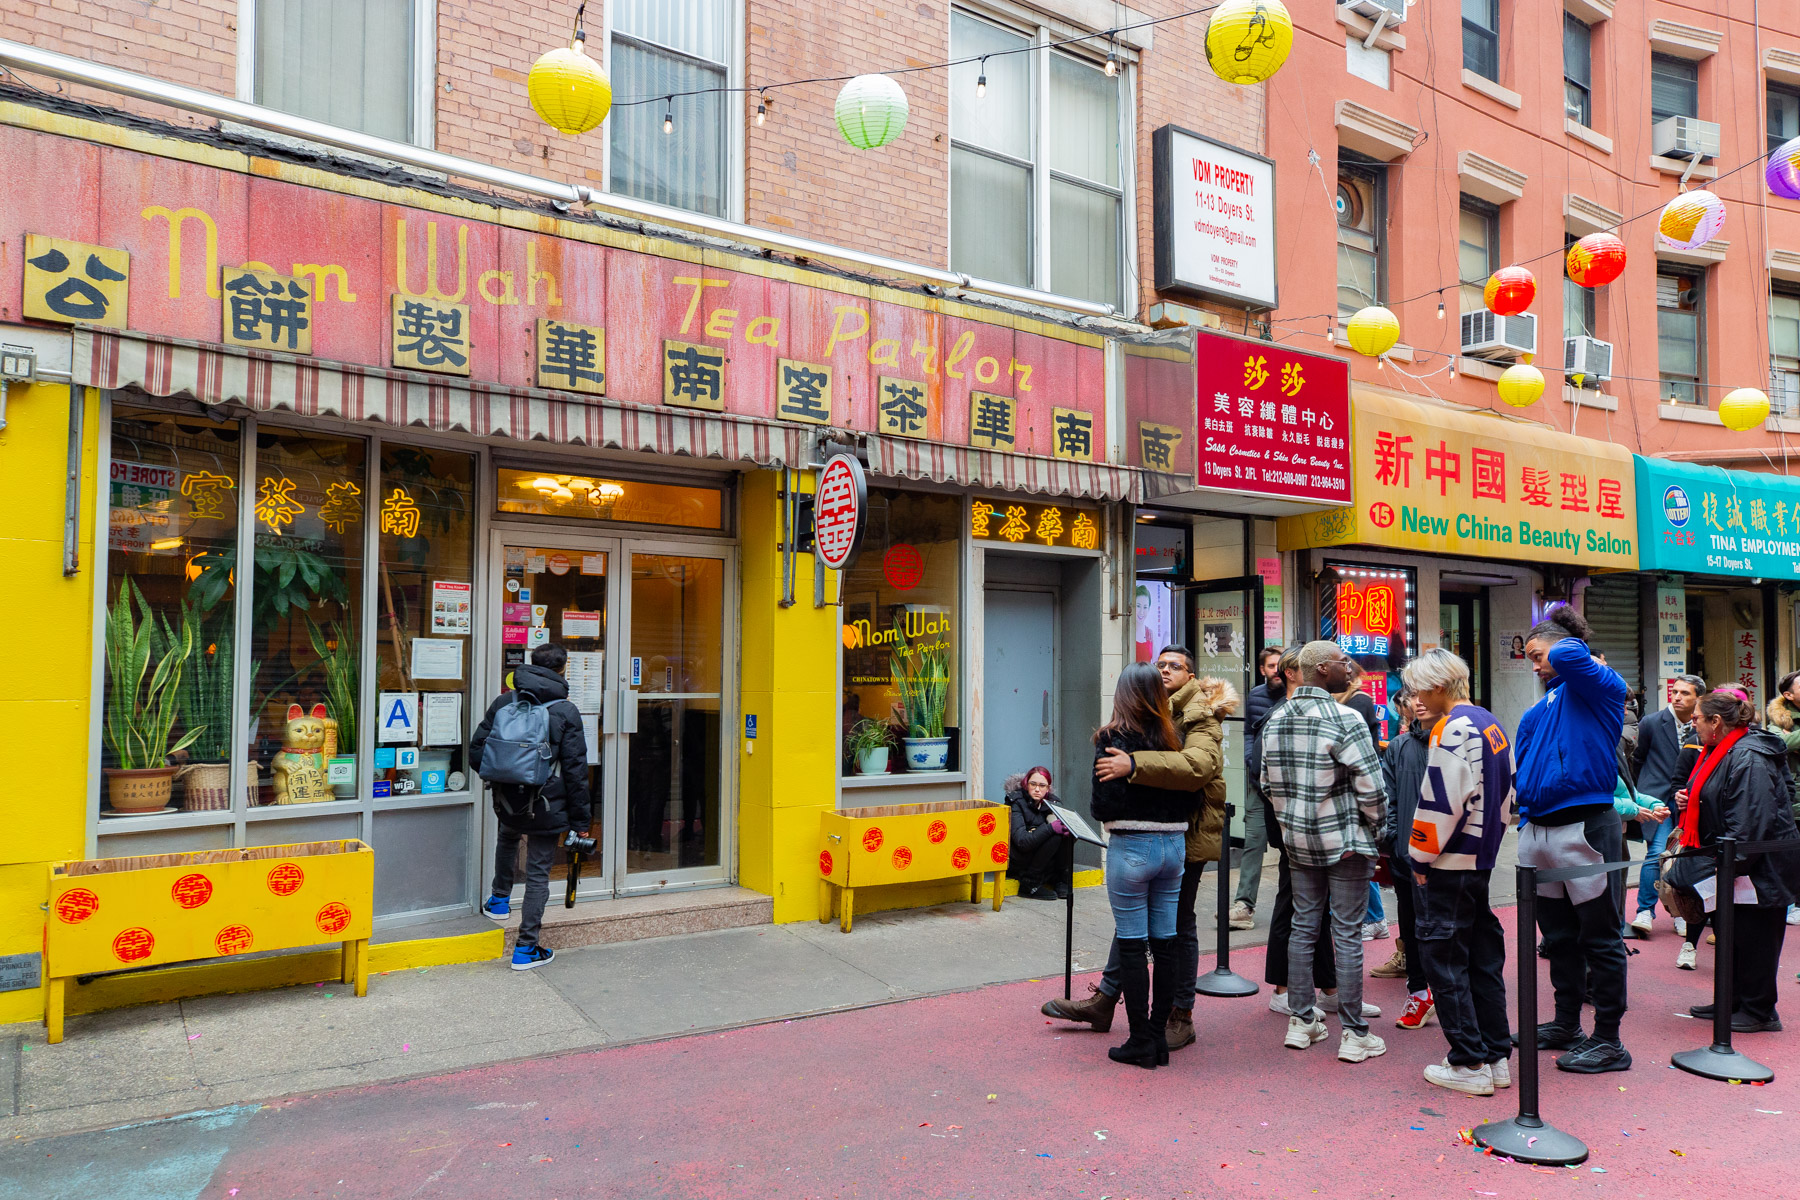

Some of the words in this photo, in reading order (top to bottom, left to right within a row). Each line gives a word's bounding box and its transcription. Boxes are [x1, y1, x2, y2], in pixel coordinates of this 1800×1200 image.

[1192, 157, 1211, 184] VDM
[1214, 164, 1254, 196] PROPERTY
[1195, 190, 1215, 211] 11-13
[1218, 196, 1243, 220] Doyers
[1245, 204, 1255, 222] St.
[1194, 218, 1257, 248] vdmdoyers@gmail.com
[141, 205, 356, 303] Nm
[397, 219, 563, 307] Wah
[672, 275, 781, 348] Tea
[824, 305, 1034, 392] Parlor
[1243, 354, 1306, 397] 莎莎
[1213, 391, 1335, 431] 美容纖體中心
[1205, 436, 1226, 453] Sasa
[1229, 444, 1261, 459] Cosmetics
[1264, 450, 1270, 459] &
[1273, 450, 1289, 462] Skin
[1291, 453, 1307, 465] Care
[1310, 455, 1330, 470] Beauty
[1204, 461, 1211, 475] 13
[1212, 462, 1232, 479] Doyers
[1234, 465, 1242, 478] St.
[1374, 430, 1625, 520] 新中國髮型屋
[584, 488, 602, 507] 13
[1666, 507, 1688, 521] LOTTERY
[1373, 505, 1391, 524] 15
[1401, 505, 1450, 536] New
[1456, 513, 1513, 544] China
[1519, 521, 1581, 556] Beauty
[1586, 529, 1632, 556] Salon
[1663, 529, 1696, 546] 六合彩
[1710, 535, 1737, 552] TINA
[1723, 555, 1744, 571] Doyers
[853, 619, 899, 648] Nom
[906, 608, 950, 638] Wah
[898, 645, 913, 657] Tea
[917, 641, 950, 653] Parlor
[384, 698, 411, 728] A
